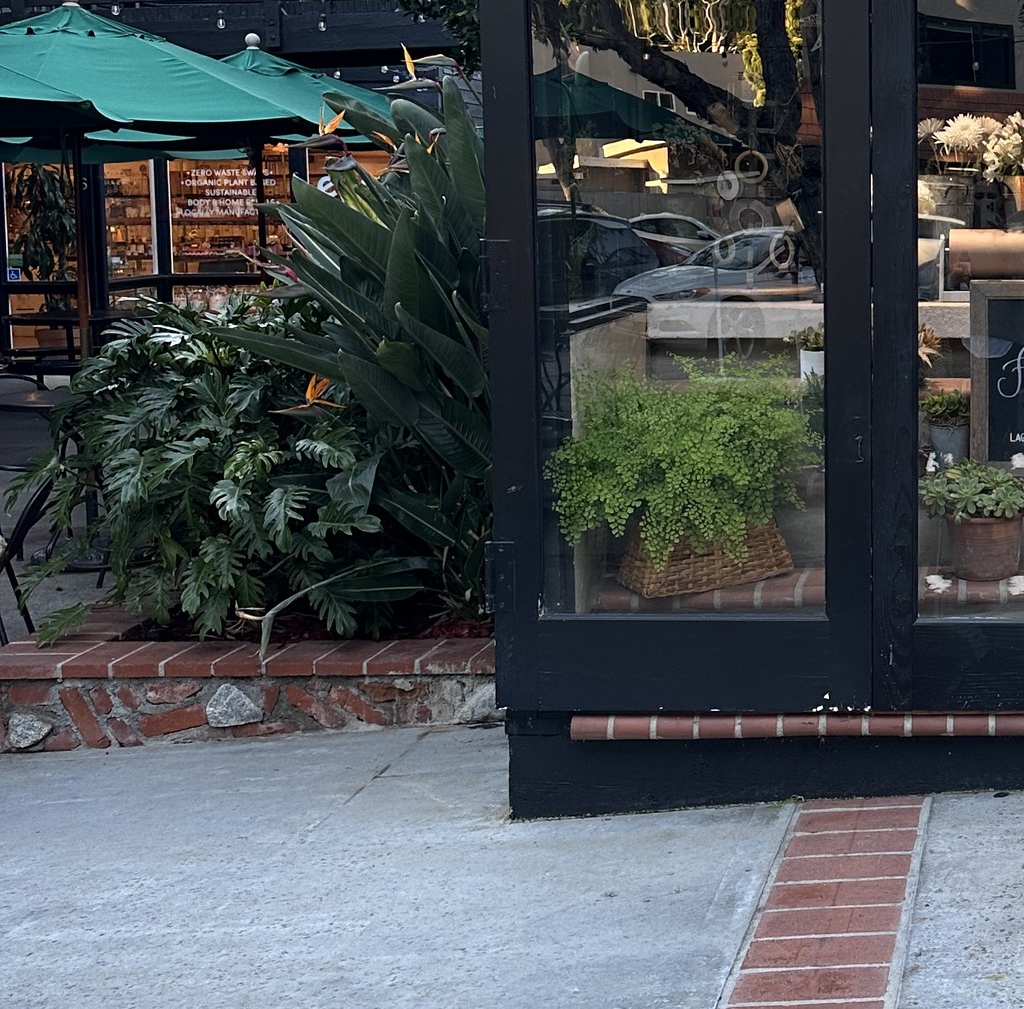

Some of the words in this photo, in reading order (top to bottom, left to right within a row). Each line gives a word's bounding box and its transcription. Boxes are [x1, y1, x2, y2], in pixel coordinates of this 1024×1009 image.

[190, 168, 212, 177] ZERO
[213, 168, 240, 177] WASTE
[184, 178, 222, 187] ORGANIC
[223, 178, 248, 187] PLANT
[205, 189, 257, 197] SUSTAINABLE
[187, 198, 210, 207] BODY
[219, 198, 244, 207] HOME
